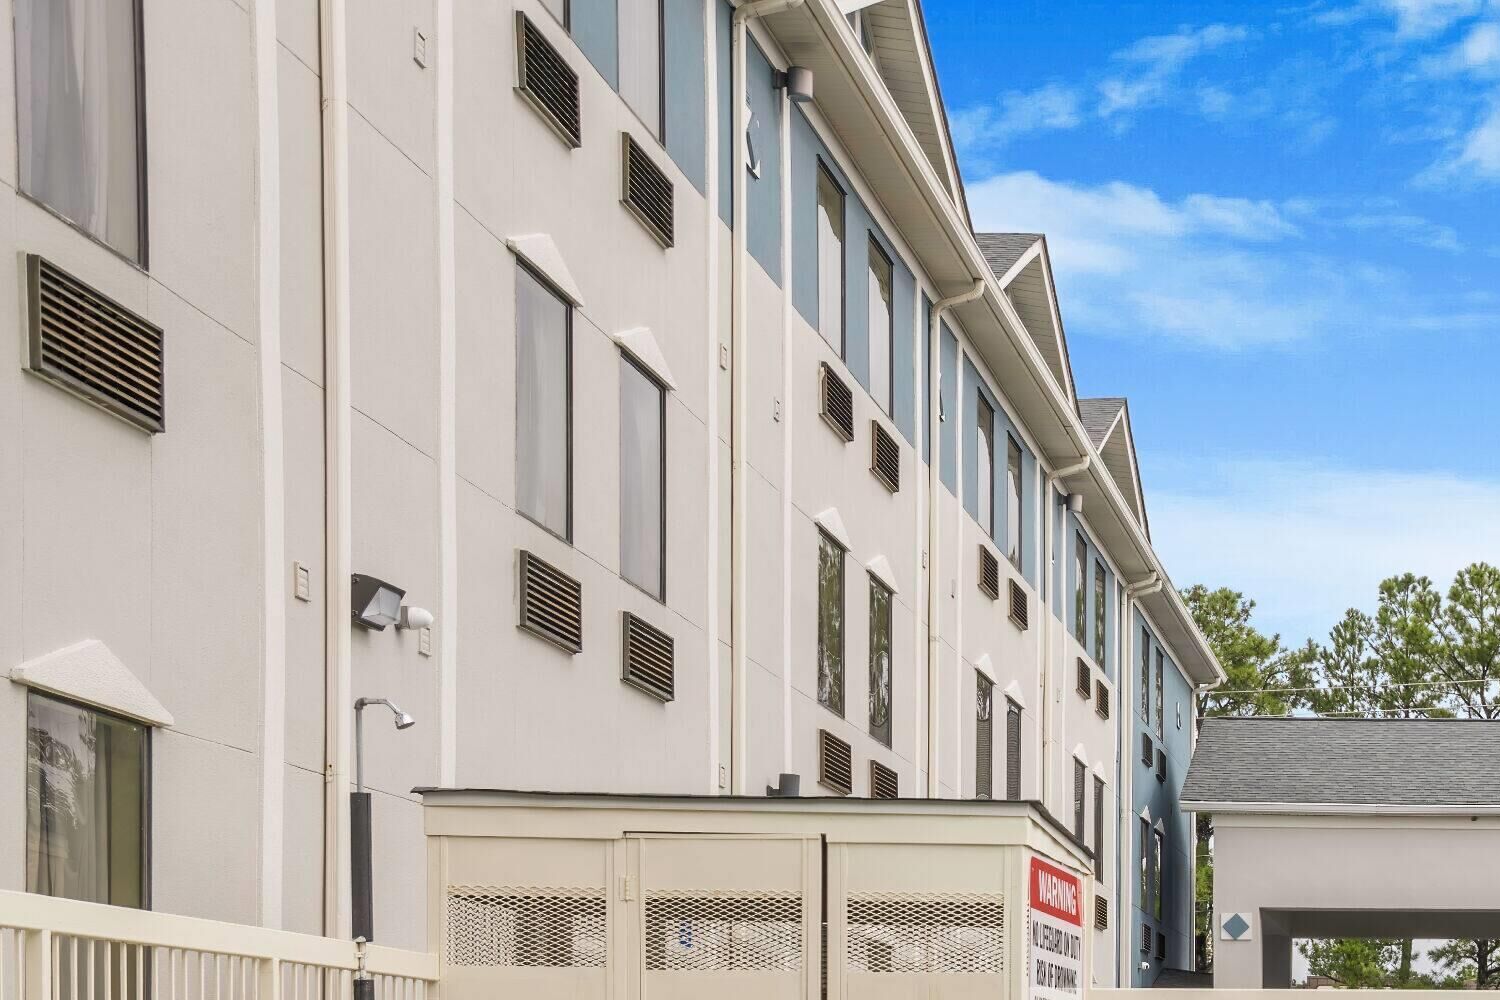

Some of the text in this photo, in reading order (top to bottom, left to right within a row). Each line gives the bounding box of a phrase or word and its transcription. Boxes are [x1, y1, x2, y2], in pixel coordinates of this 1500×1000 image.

[1038, 869, 1077, 916] WARNING
[1032, 919, 1081, 961] NO LIFEGUARD ON DUTY
[1036, 958, 1077, 995] RISK OF DROWNING
